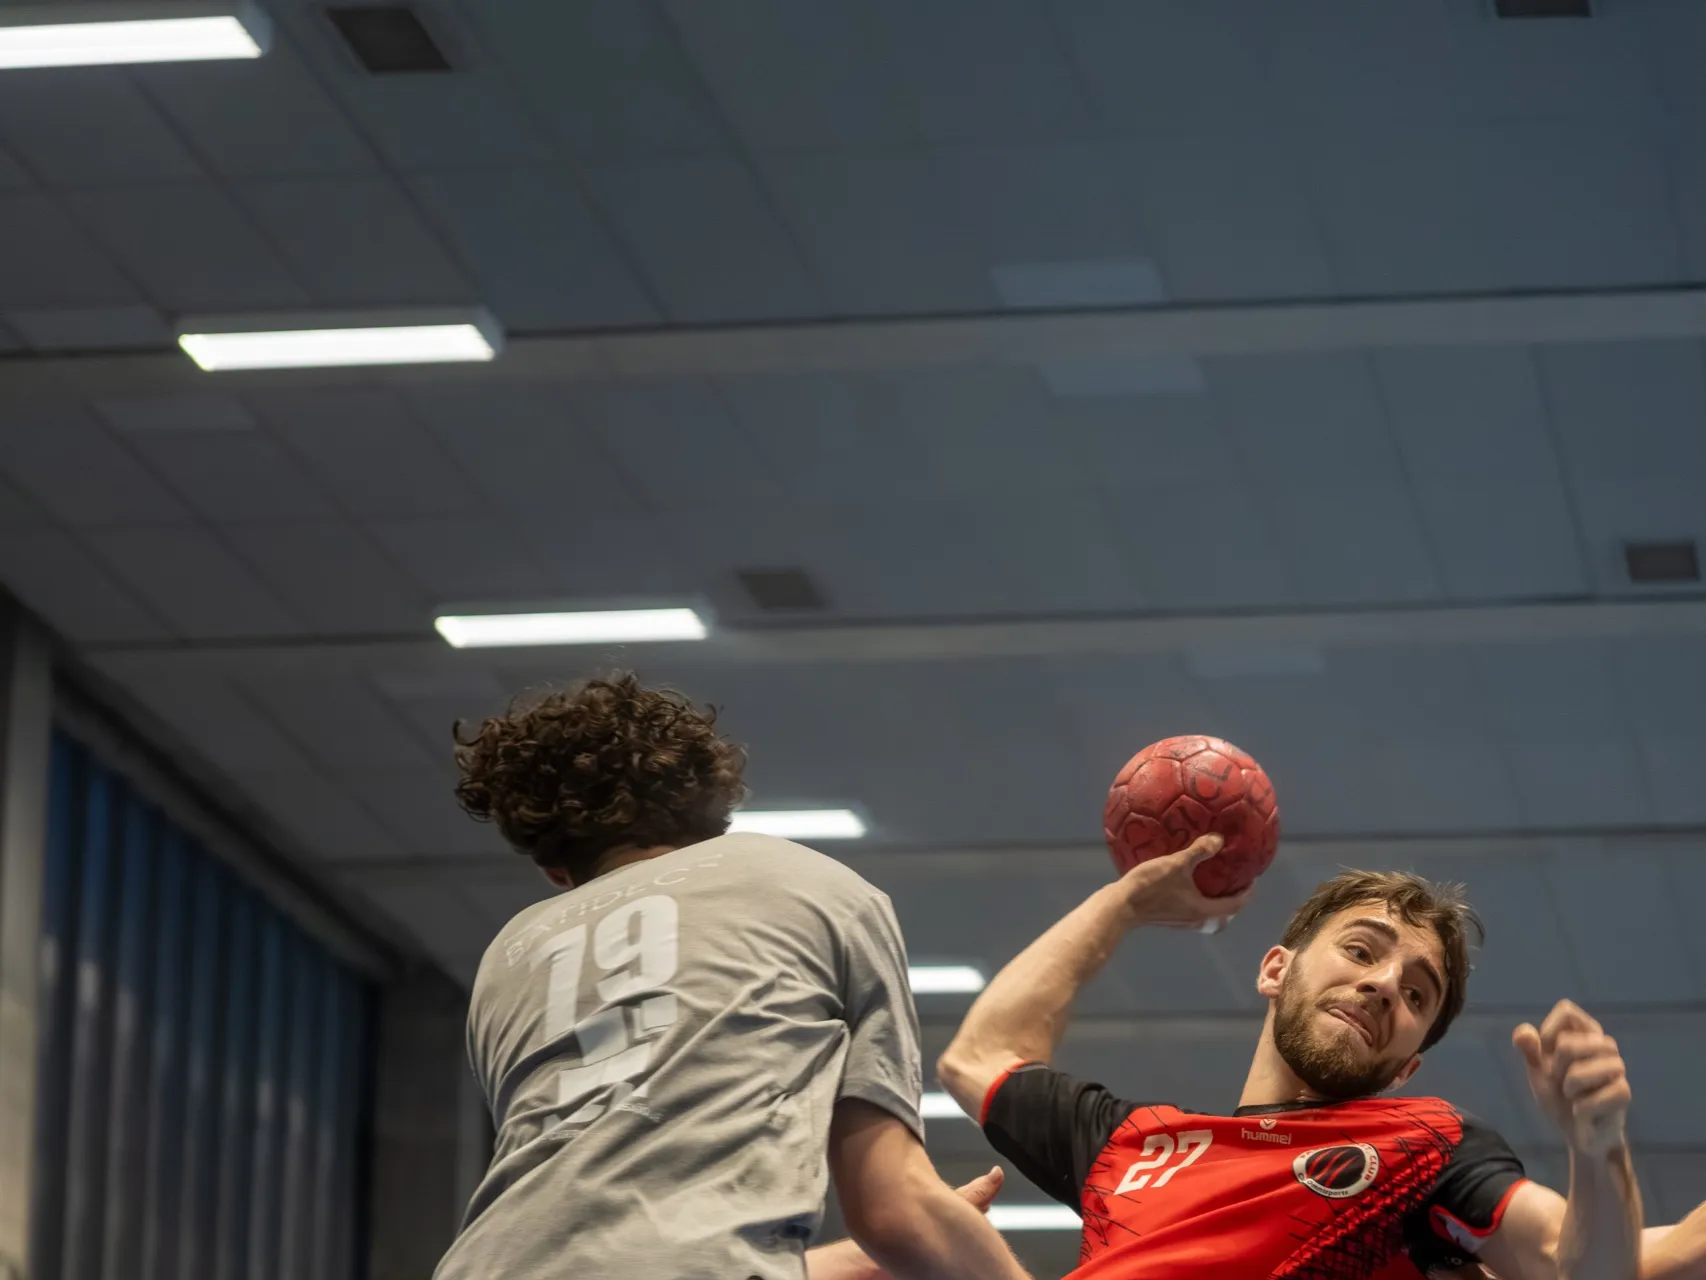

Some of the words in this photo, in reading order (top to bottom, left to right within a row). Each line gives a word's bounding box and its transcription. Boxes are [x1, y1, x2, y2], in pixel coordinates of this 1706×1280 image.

[528, 894, 680, 1108] 19
[1113, 1129, 1214, 1196] 27
[1241, 1127, 1293, 1146] hummel
